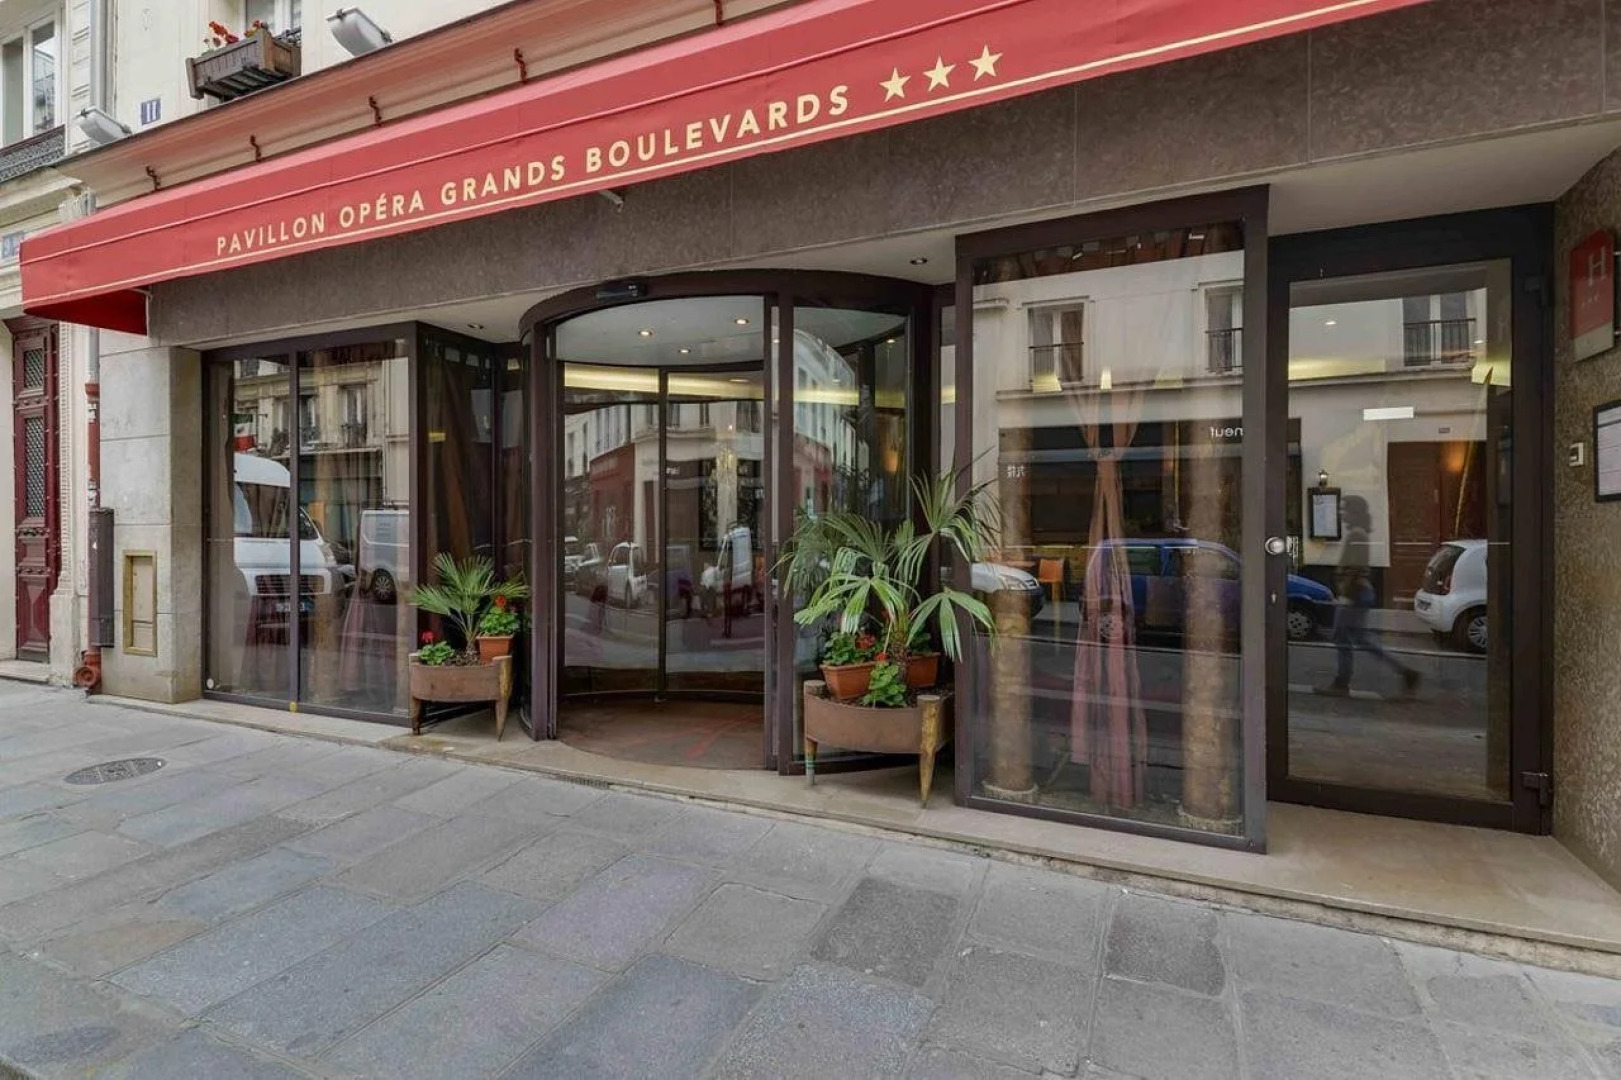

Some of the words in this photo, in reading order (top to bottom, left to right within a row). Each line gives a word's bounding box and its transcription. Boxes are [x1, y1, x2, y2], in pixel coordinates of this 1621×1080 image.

[146, 100, 157, 122] 11
[217, 212, 325, 256] PAVILLON
[339, 190, 424, 228] OPÉRA
[441, 155, 565, 205] GRANDS
[586, 85, 848, 173] BOULEVARDS
[1587, 245, 1606, 287] H
